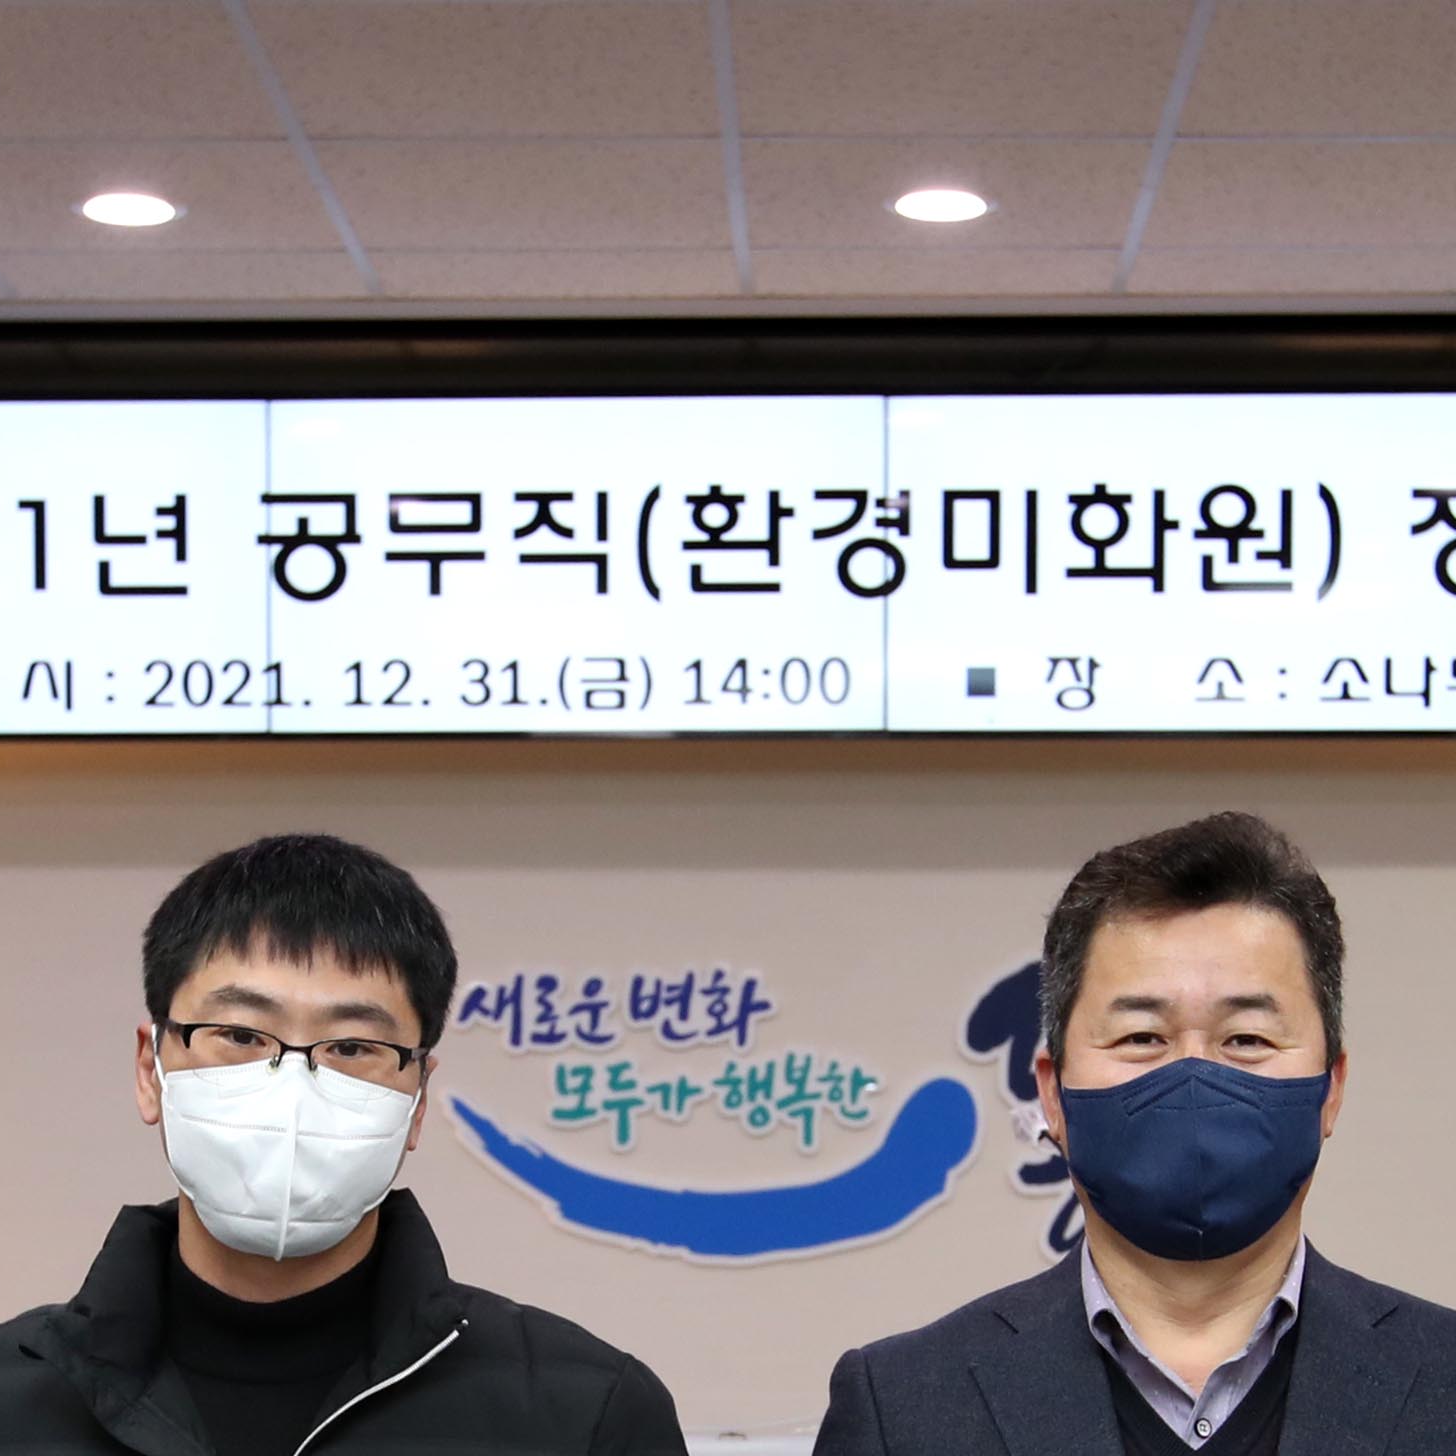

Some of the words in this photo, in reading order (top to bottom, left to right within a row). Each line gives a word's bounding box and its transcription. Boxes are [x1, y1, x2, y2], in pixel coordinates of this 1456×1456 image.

[257, 481, 1342, 600] 공무직(환경미화원)
[340, 656, 434, 709] 12.
[680, 655, 855, 707] 14:00
[458, 974, 615, 1047] 새로운
[629, 969, 771, 1047] 변화
[552, 1061, 702, 1145] 모두가
[713, 1055, 877, 1147] 행복한
